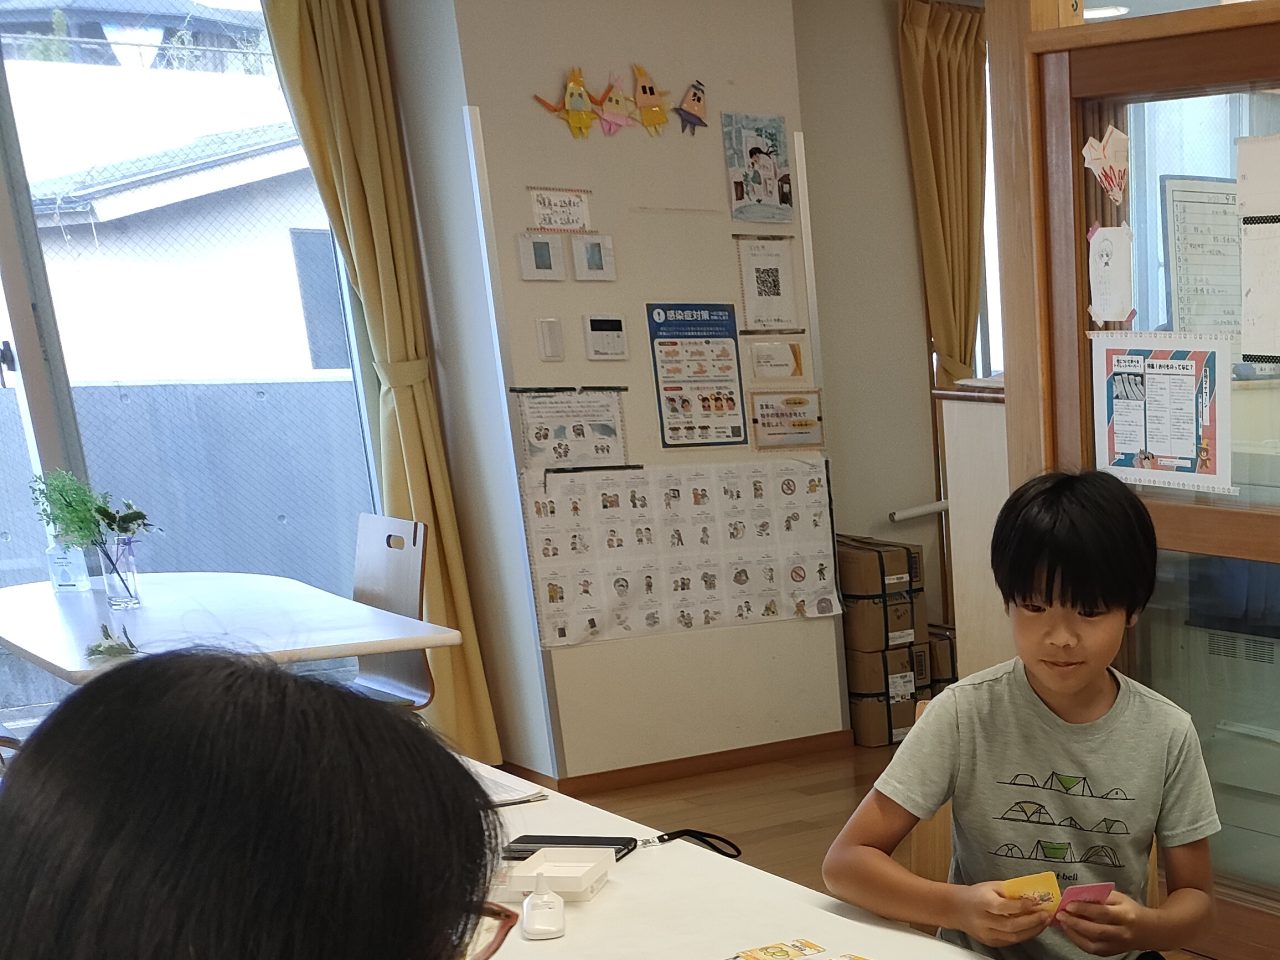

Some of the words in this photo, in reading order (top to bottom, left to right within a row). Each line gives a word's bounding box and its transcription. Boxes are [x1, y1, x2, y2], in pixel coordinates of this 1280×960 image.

[666, 310, 710, 321] 感染症対策
